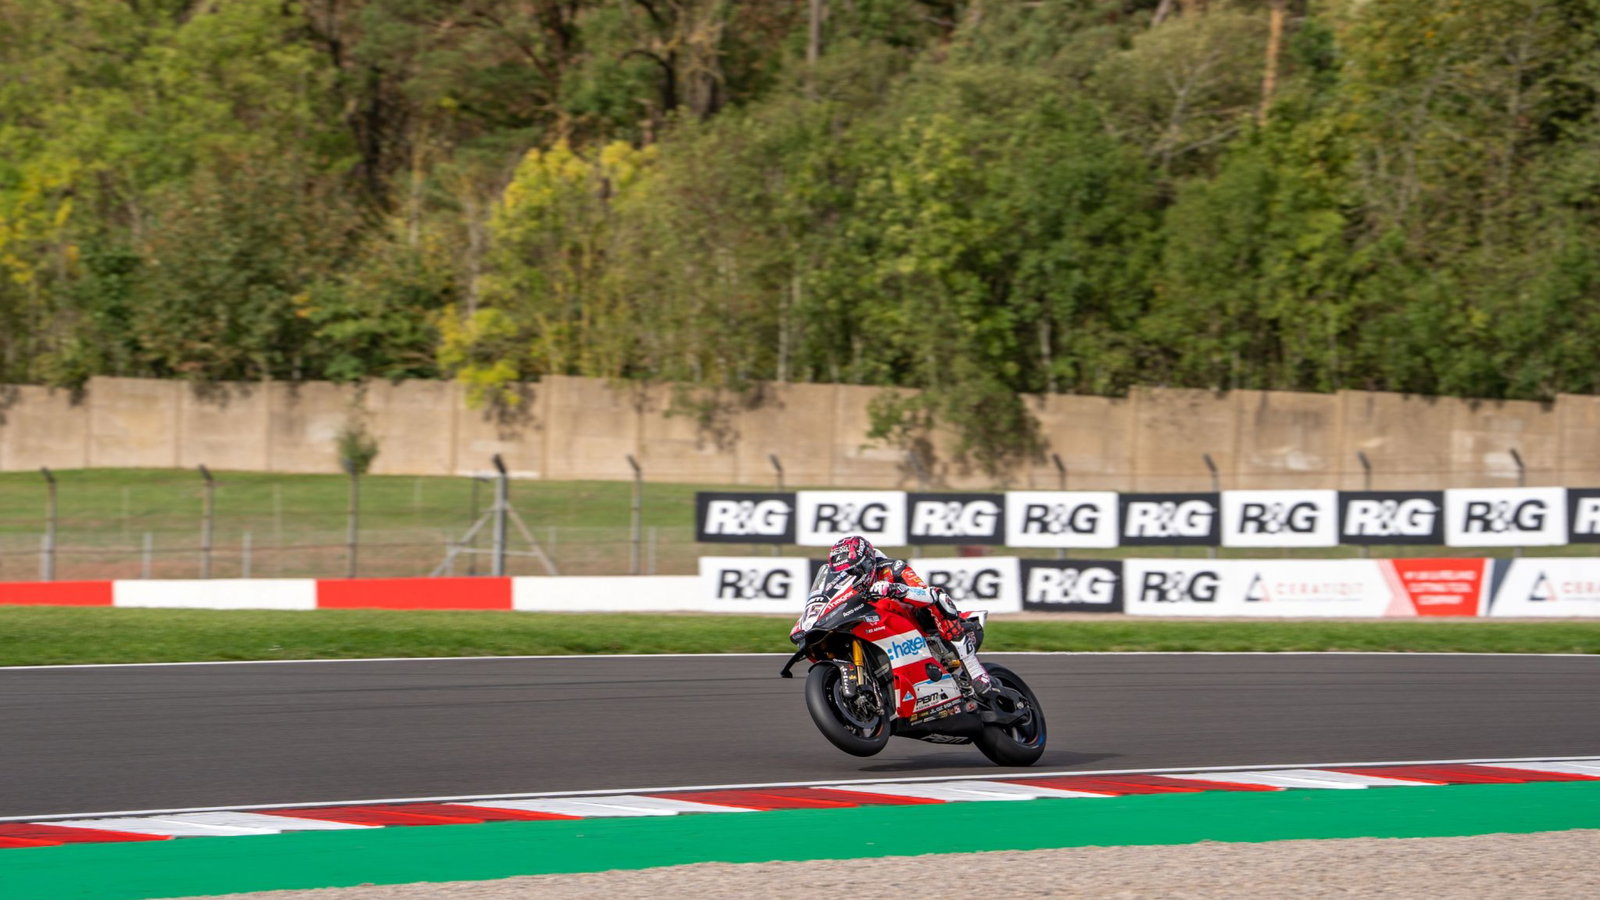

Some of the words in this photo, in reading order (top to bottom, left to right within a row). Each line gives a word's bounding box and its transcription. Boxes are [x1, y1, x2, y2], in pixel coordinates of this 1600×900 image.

[704, 499, 791, 535] R&G
[812, 502, 890, 533] R&G
[911, 501, 1000, 536] R&G
[1022, 503, 1100, 534] R&G
[1124, 500, 1217, 537] R&G
[1238, 501, 1318, 534] R&G
[1343, 498, 1440, 536] R&G
[1463, 499, 1549, 533] R&G
[717, 568, 792, 600] R&G
[1026, 567, 1118, 604] R&G
[1139, 570, 1220, 602] R&G
[916, 692, 939, 707] PBM
